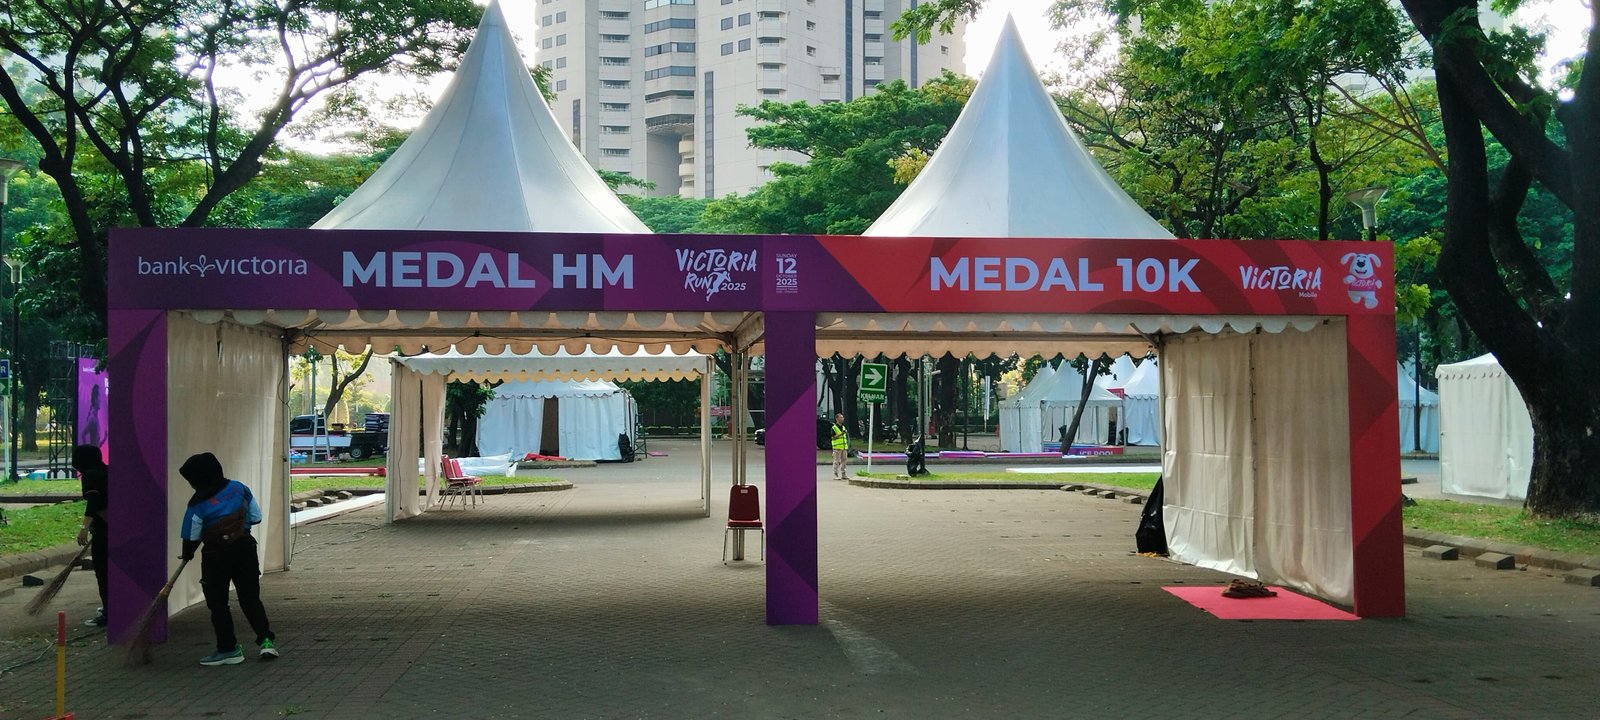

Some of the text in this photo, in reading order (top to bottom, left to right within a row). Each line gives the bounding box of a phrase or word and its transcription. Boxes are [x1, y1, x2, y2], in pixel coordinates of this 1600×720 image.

[138, 256, 308, 275] bank victoria
[342, 251, 634, 290] MEDAL HM
[776, 258, 797, 273] 12
[930, 256, 1202, 293] MEDAL 10K
[684, 272, 746, 293] RUN 2025
